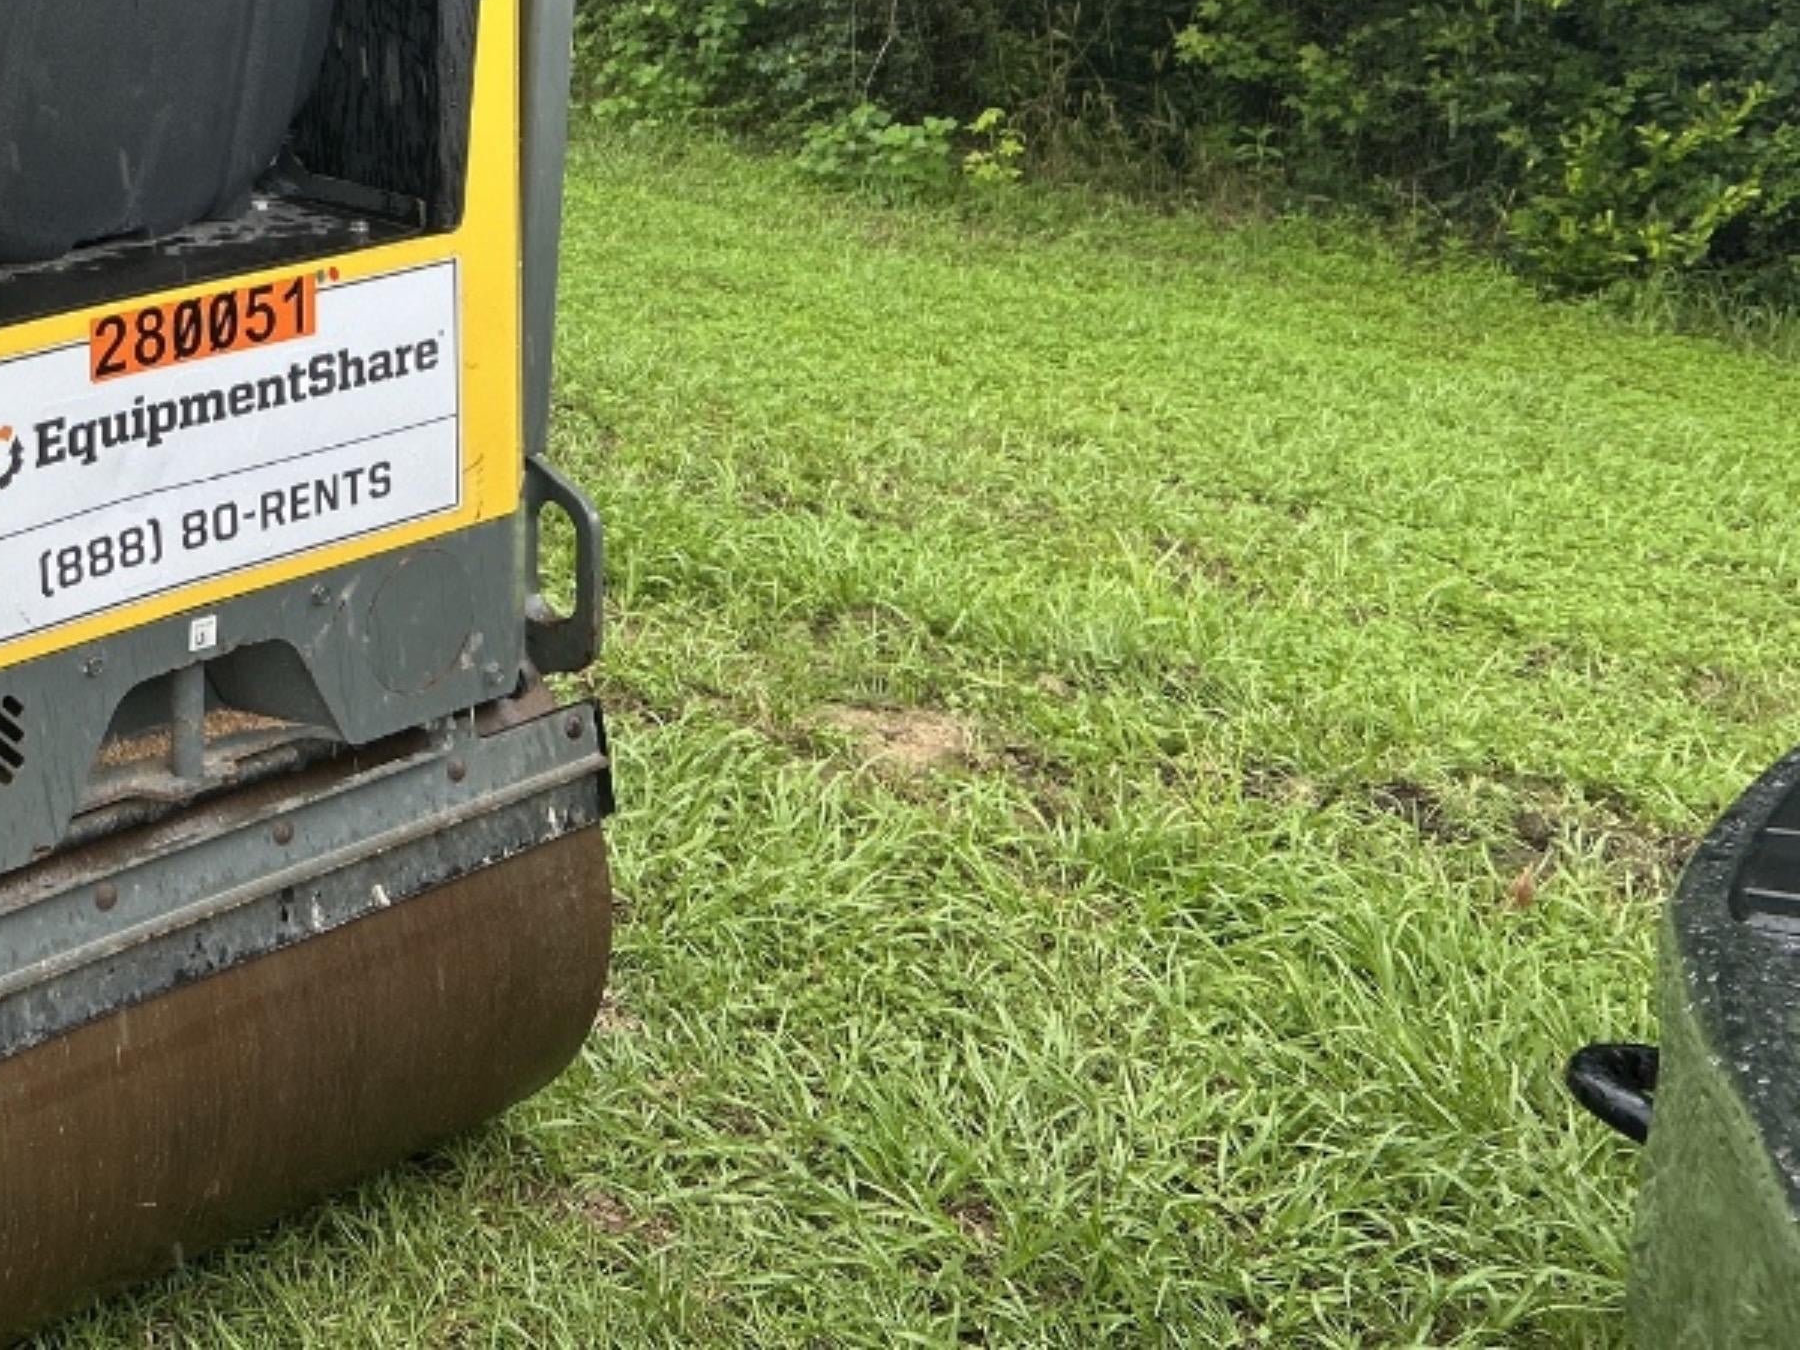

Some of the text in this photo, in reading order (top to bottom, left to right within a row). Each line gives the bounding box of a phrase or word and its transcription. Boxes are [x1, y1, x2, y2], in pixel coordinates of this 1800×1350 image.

[95, 275, 304, 377] 280051
[34, 337, 440, 468] EquipmentShare
[39, 461, 393, 598] (888) 80-RENTS
